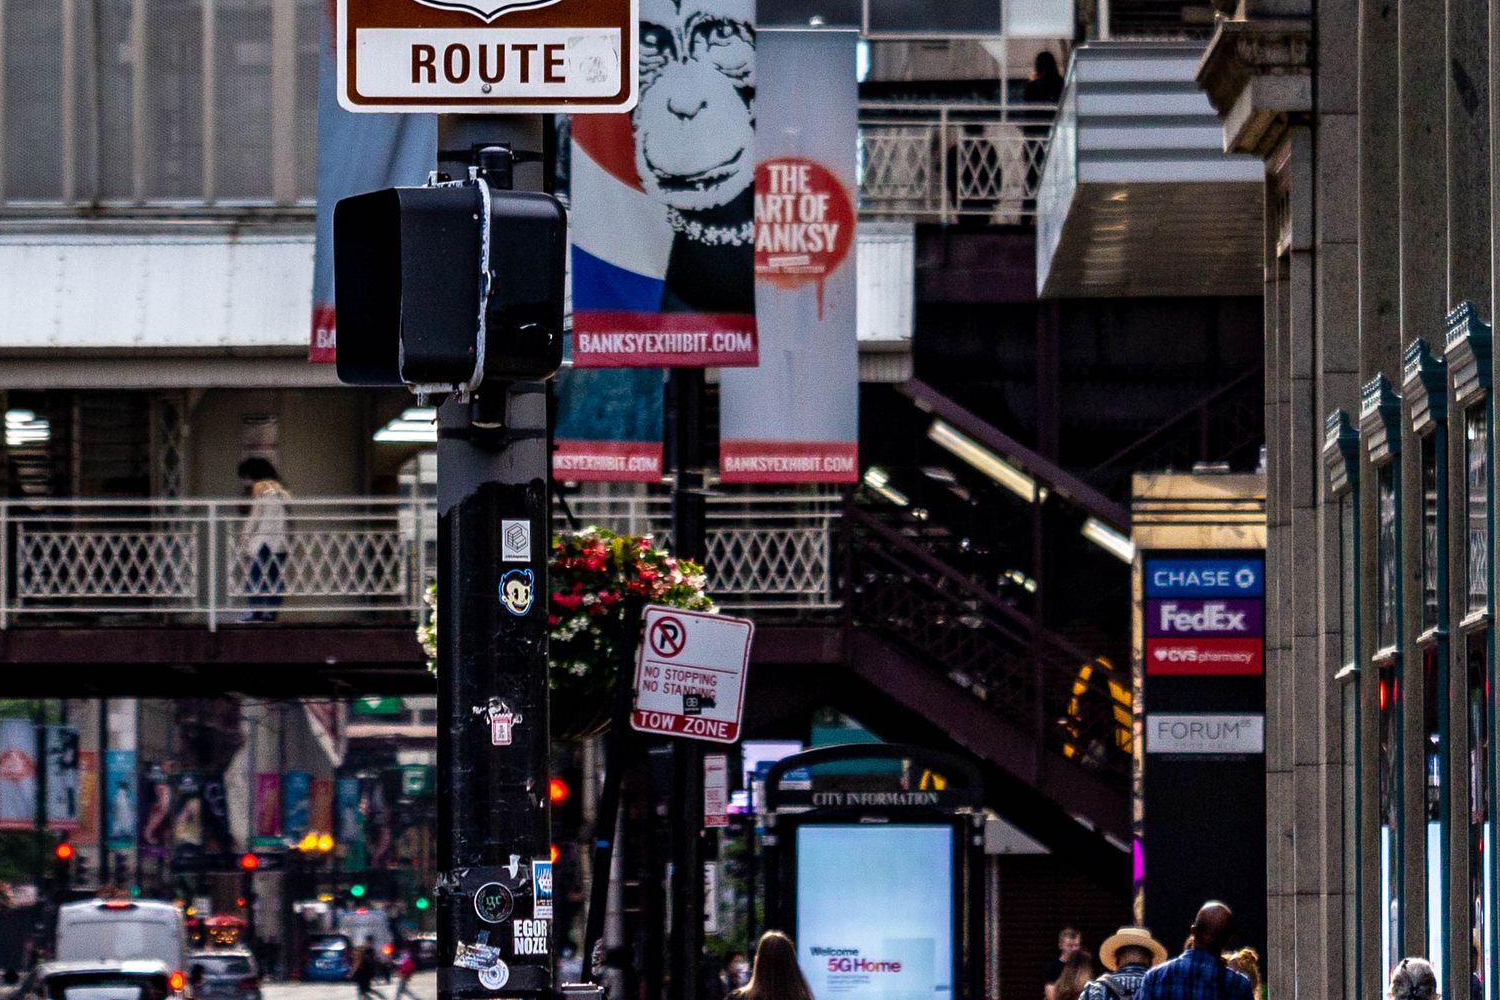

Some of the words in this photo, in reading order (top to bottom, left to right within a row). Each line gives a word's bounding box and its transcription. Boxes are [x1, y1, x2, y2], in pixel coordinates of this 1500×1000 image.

[411, 43, 567, 84] ROUTE
[767, 164, 812, 194] THE
[799, 194, 831, 223] OF
[755, 223, 839, 253] ANKSY
[578, 332, 752, 354] BANKSYEXHIBIT.COM
[724, 455, 854, 472] BANKSYEXHIBIT.COM
[1154, 571, 1230, 587] CHASE
[1160, 603, 1247, 632] FedEx
[1168, 649, 1198, 662] CVS
[644, 665, 660, 679] NO
[664, 668, 718, 687] STOPPING
[642, 680, 659, 693] NO
[663, 682, 717, 700] STANDING
[641, 711, 676, 730] TOW
[682, 717, 729, 738] ZONE
[813, 792, 843, 806] CITY
[846, 792, 939, 806] INFORMATION
[513, 919, 548, 937] EGOR
[514, 937, 548, 955] NOZEL
[810, 946, 859, 956] Welcome
[828, 958, 852, 972] 5G
[854, 958, 901, 972] Home
